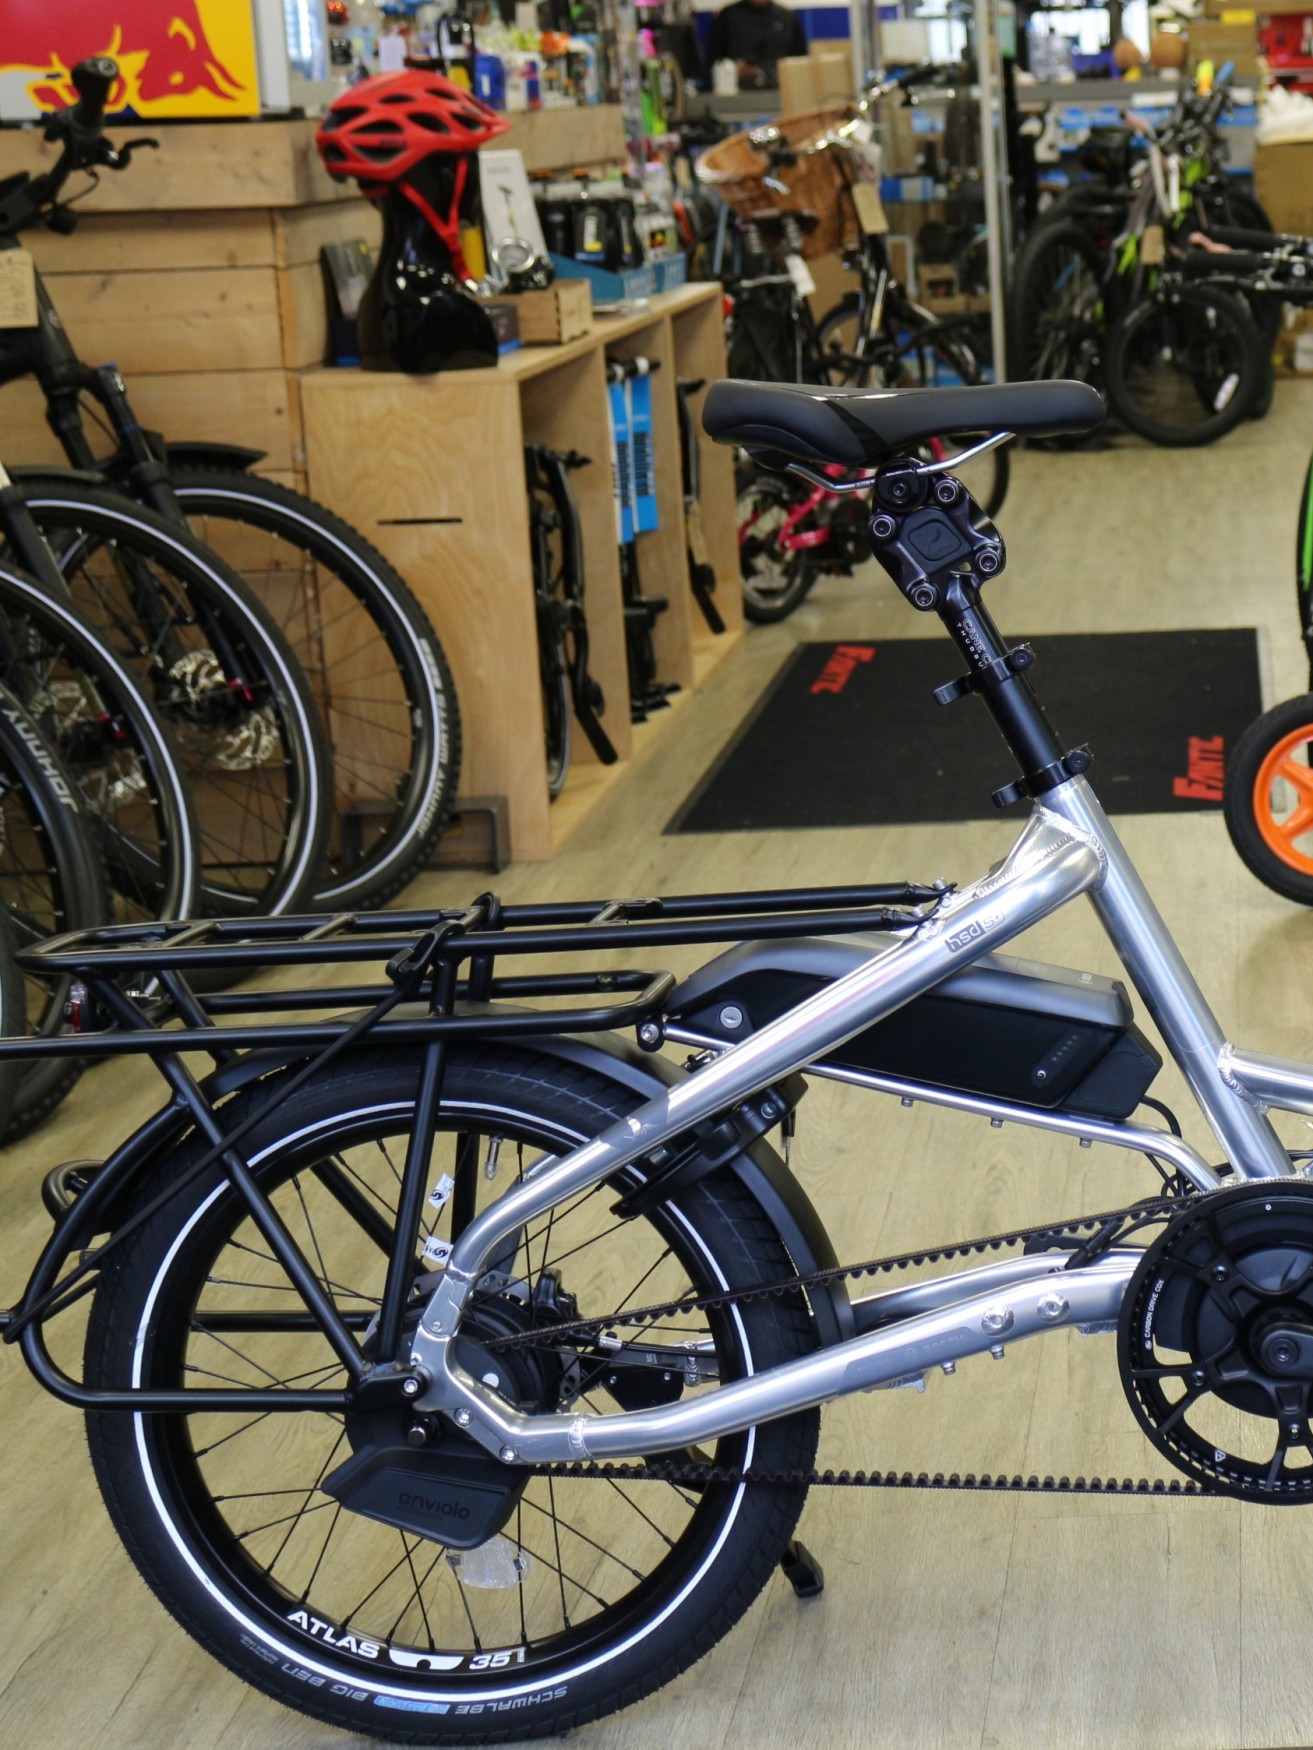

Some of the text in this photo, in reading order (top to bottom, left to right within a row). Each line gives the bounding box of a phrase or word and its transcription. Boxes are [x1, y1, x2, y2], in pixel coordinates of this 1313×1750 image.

[944, 920, 985, 953] hsd
[1148, 1292, 1159, 1312] DRIVE
[1144, 1311, 1155, 1338] CARBON
[286, 1610, 380, 1659] ATLAS
[280, 1662, 328, 1688] BEN
[329, 1684, 369, 1702] BIG
[454, 1685, 568, 1715] SCHWALBE
